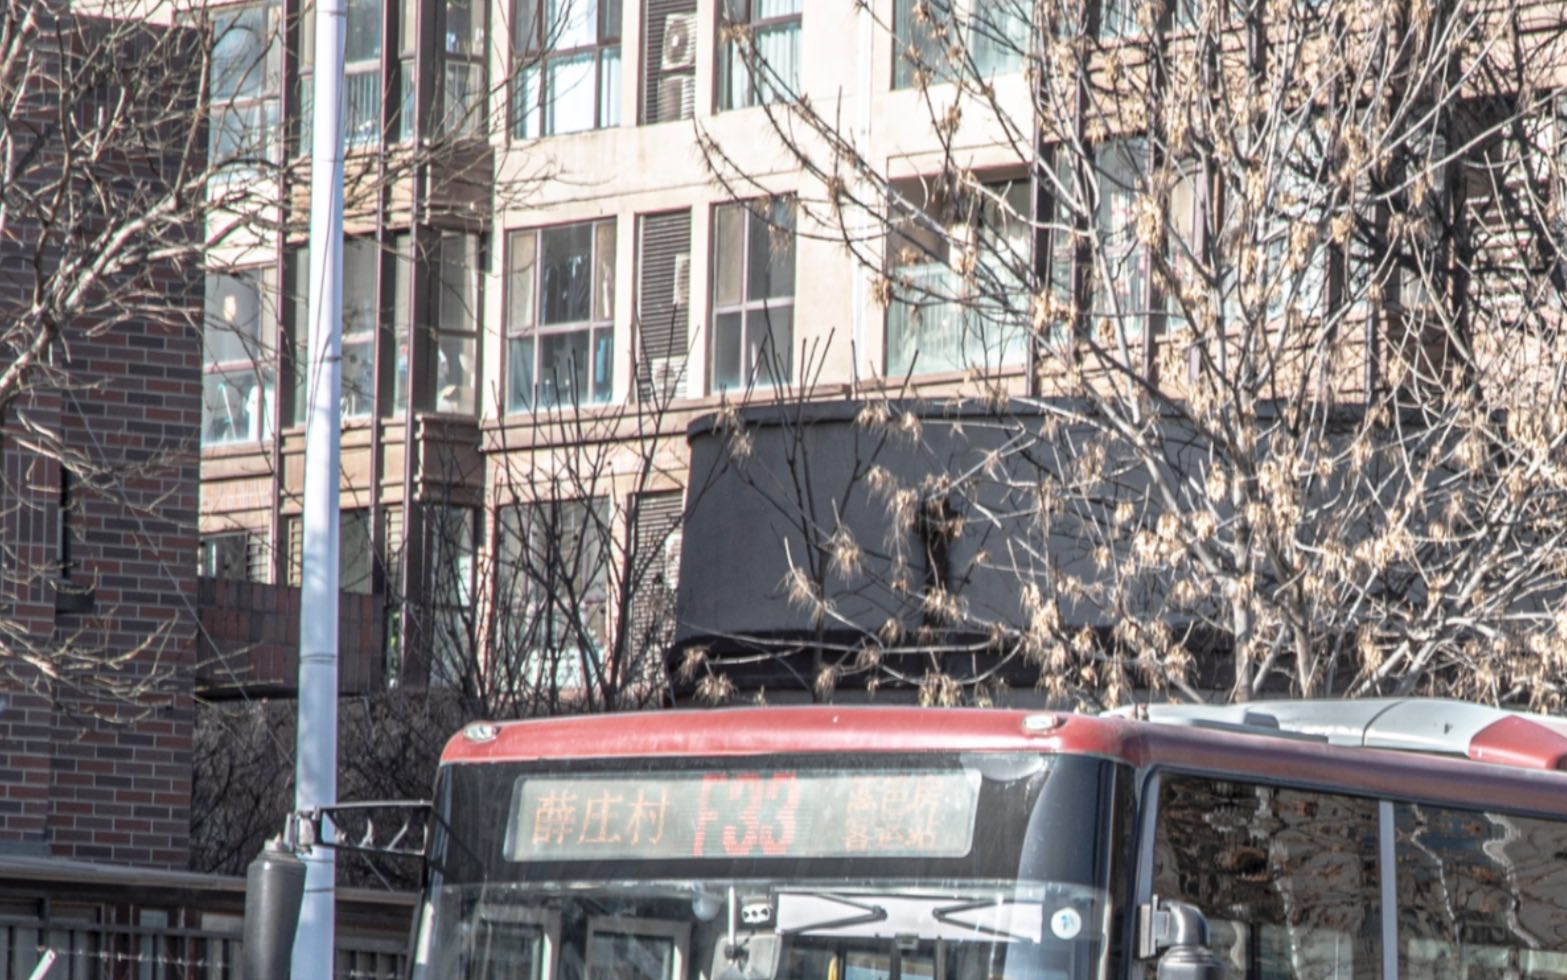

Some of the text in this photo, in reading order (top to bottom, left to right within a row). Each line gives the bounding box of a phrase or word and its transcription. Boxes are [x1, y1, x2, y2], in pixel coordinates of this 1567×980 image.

[530, 787, 671, 847] 薛庄村
[692, 772, 802, 857] F33
